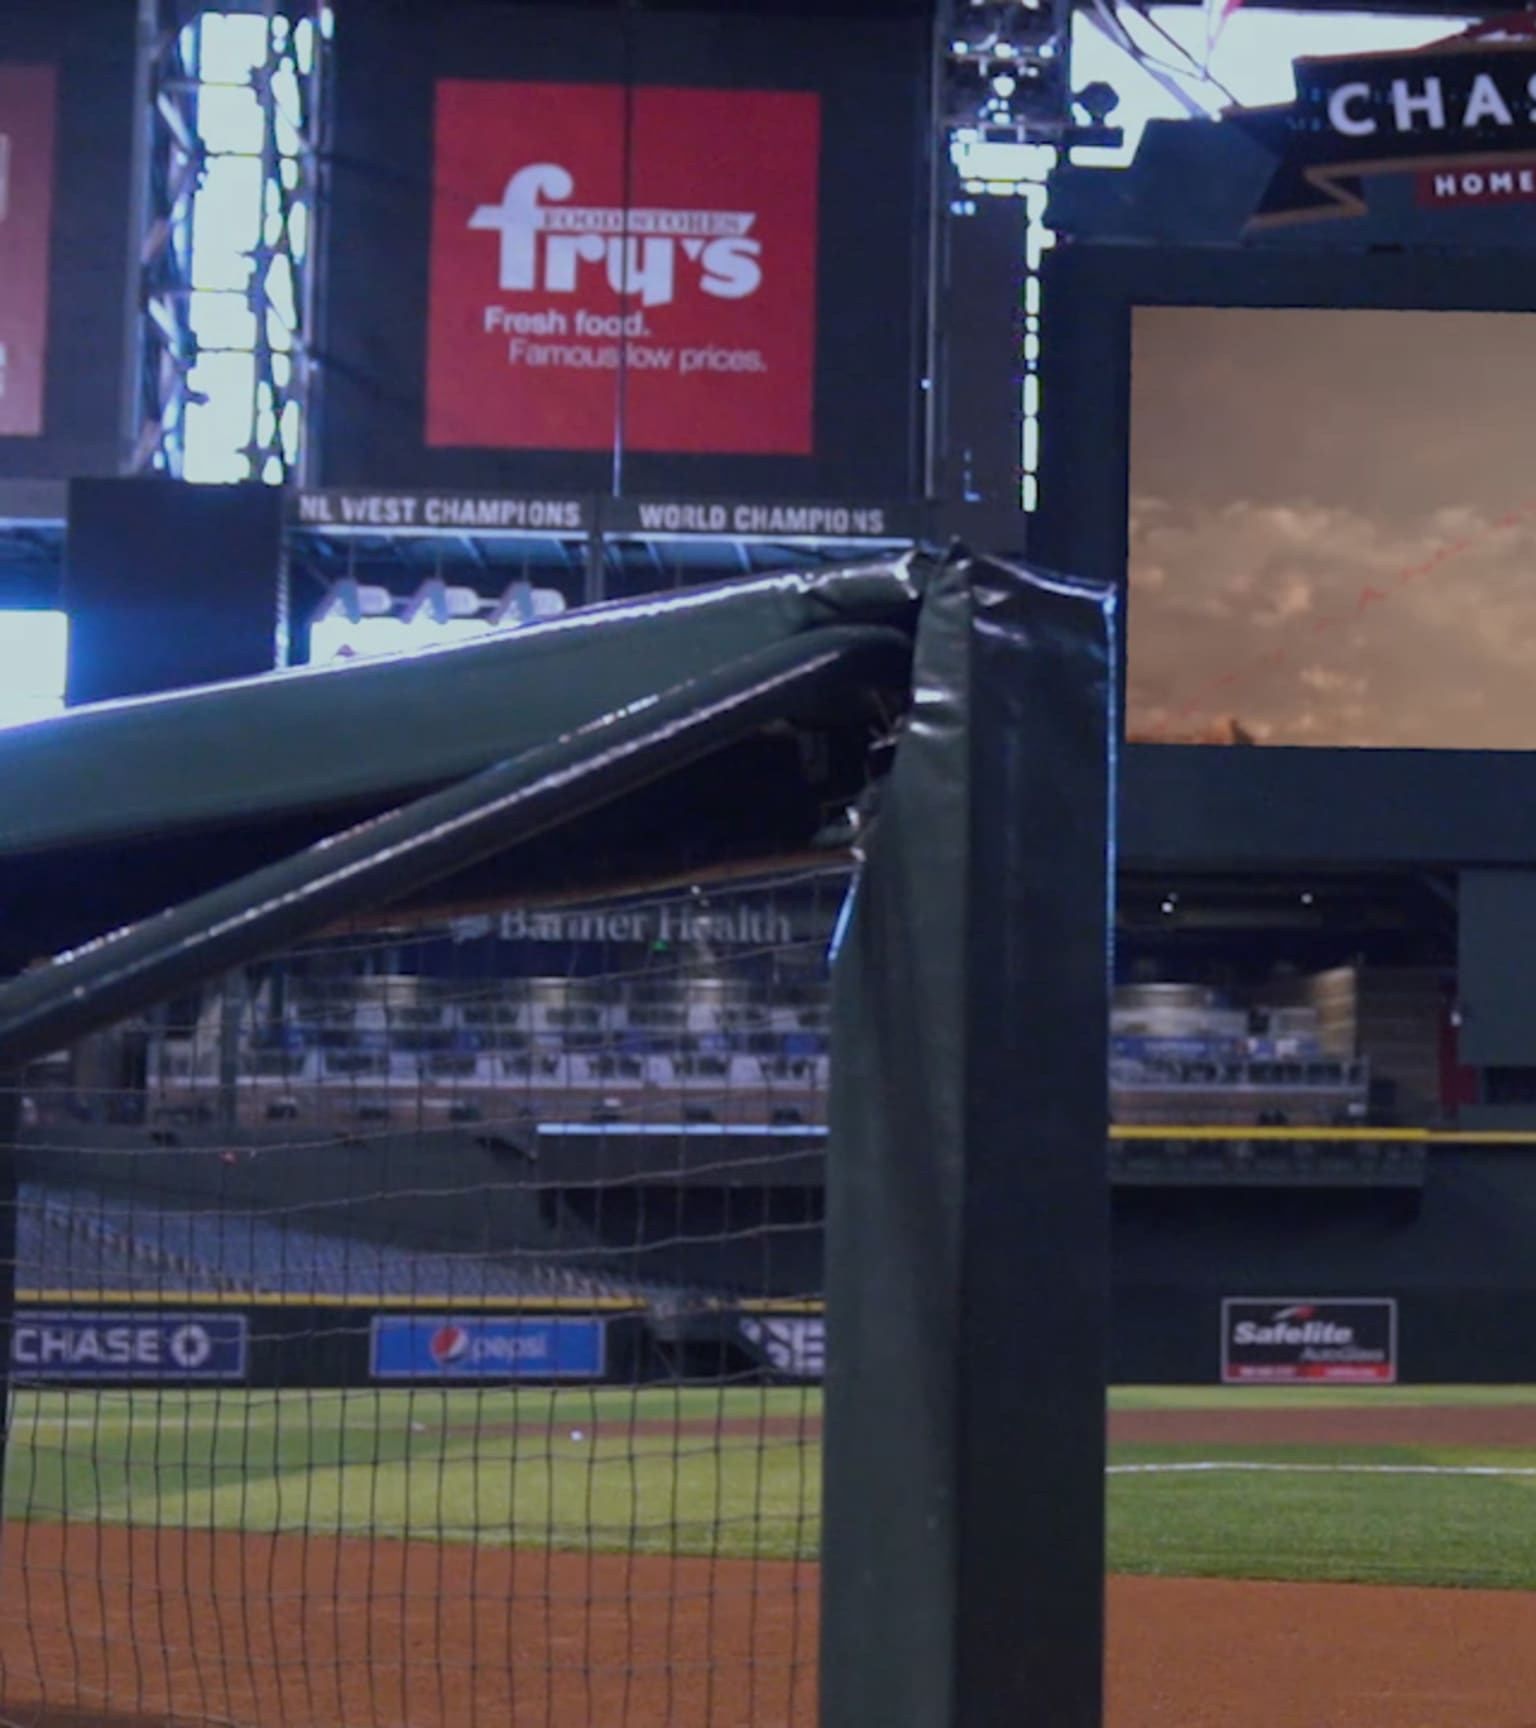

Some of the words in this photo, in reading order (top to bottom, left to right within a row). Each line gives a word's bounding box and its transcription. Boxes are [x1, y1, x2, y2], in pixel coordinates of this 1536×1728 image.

[1434, 170, 1536, 197] HOME
[467, 162, 763, 307] fry's
[484, 305, 567, 336] Fresh
[574, 308, 652, 338] food.
[508, 336, 621, 368] Famous
[625, 341, 673, 369] low
[679, 343, 768, 375] prices.
[300, 496, 333, 521] NL
[340, 497, 417, 524] WEST
[424, 499, 581, 527] CHAMPIONS
[638, 503, 727, 531] WORLD
[732, 506, 885, 535] CHAMPIONS
[500, 906, 648, 942] Banner
[658, 905, 792, 944] Health
[13, 1327, 162, 1364] CHASE
[1232, 1321, 1354, 1345] Safelite
[471, 1335, 547, 1364] pepsi
